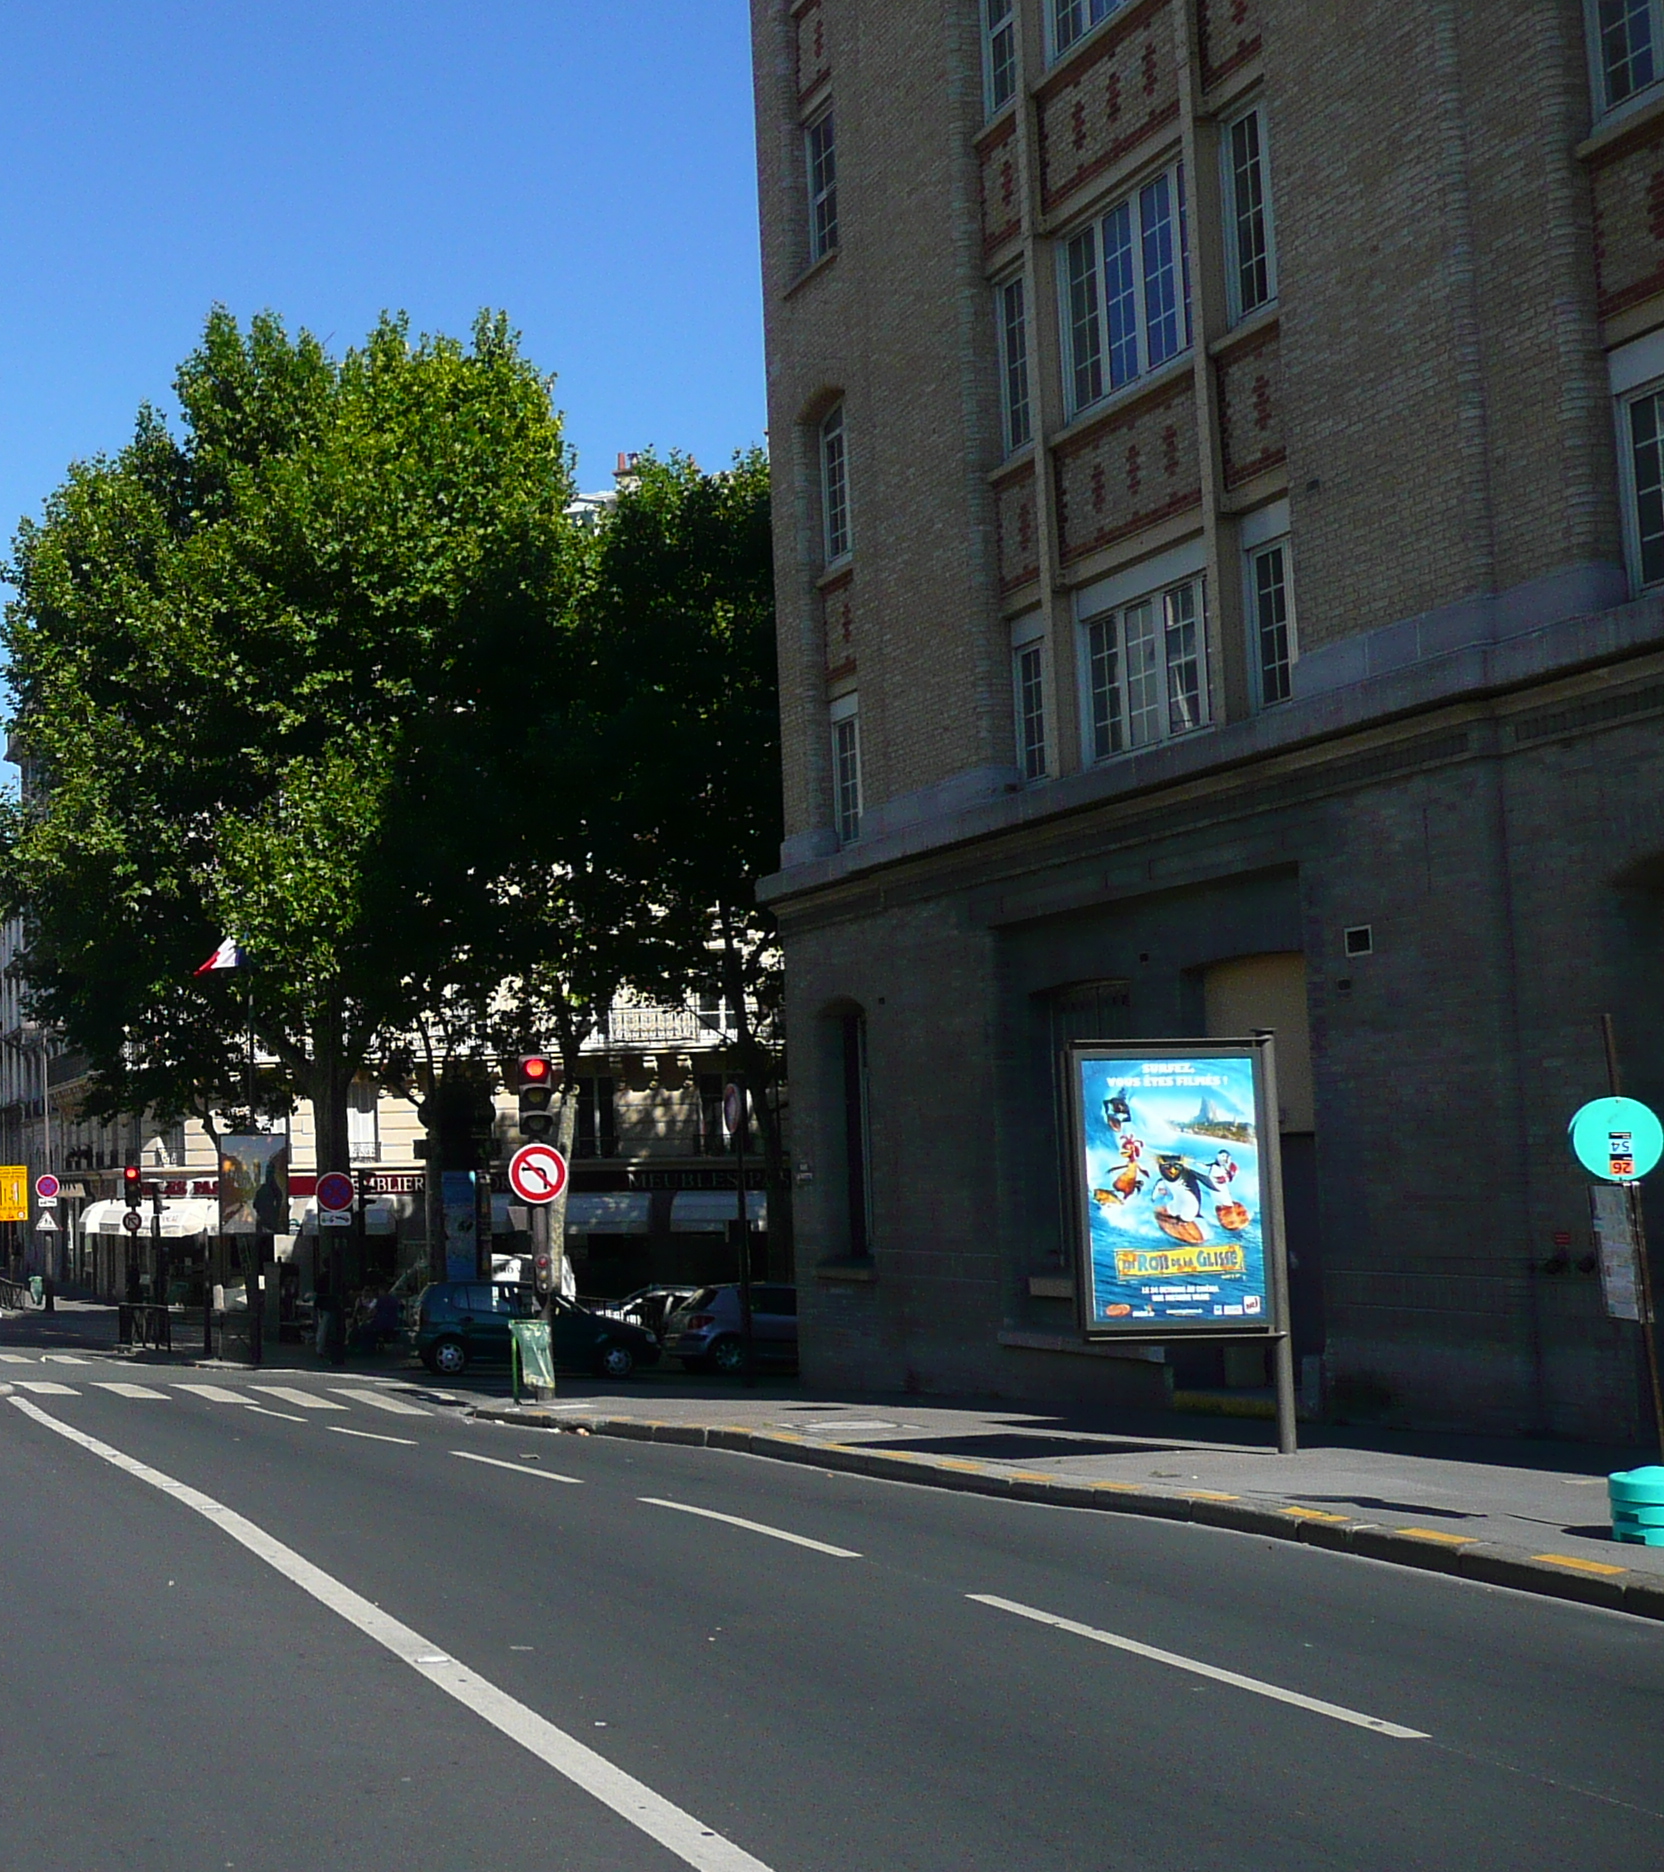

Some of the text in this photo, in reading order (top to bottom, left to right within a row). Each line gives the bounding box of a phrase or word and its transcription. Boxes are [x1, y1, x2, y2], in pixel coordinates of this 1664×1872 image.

[1106, 1077, 1141, 1087] VOUS
[1142, 1073, 1174, 1087] ÊTES
[1176, 1073, 1221, 1087] FILMÉS
[1611, 1141, 1630, 1152] 54
[1613, 1162, 1632, 1174] 26
[628, 1172, 738, 1188] MEUBLES
[1195, 1249, 1239, 1268] GLISSE
